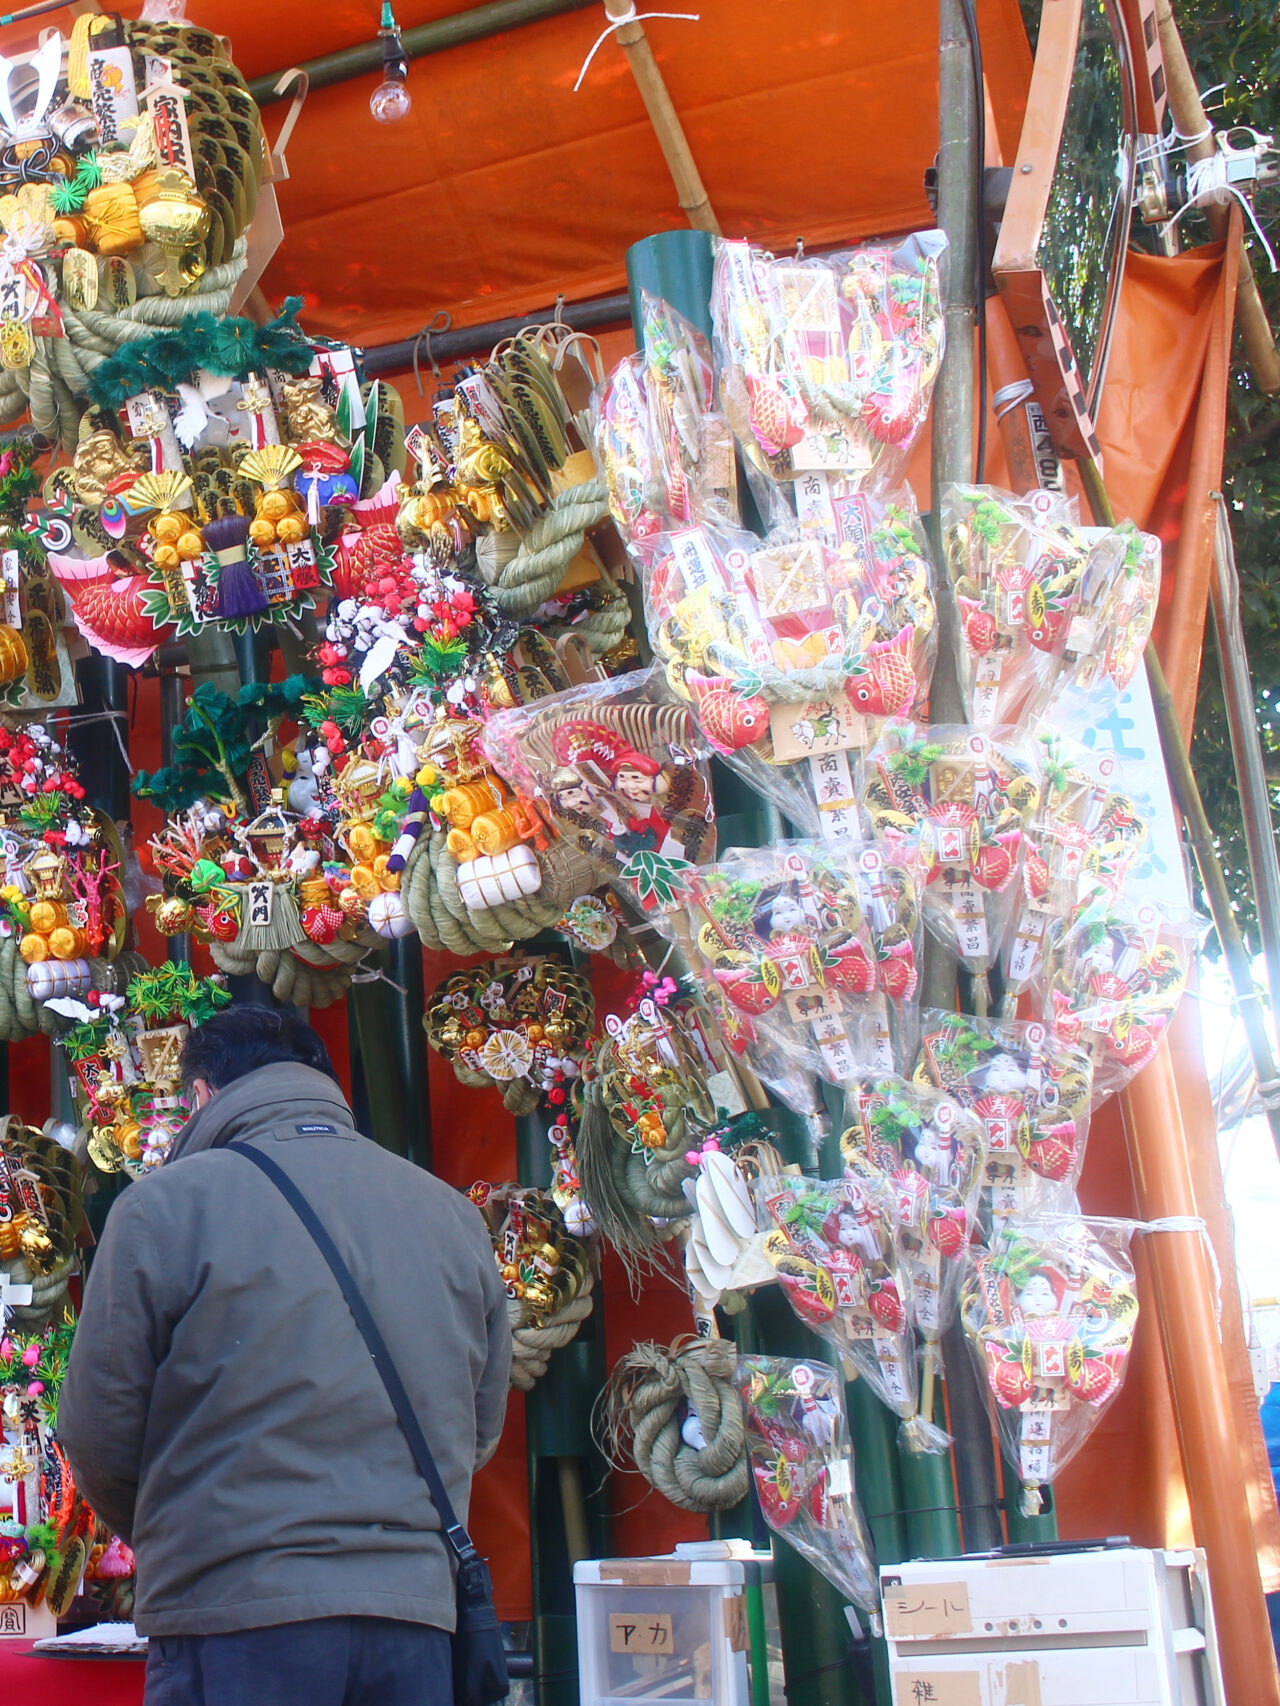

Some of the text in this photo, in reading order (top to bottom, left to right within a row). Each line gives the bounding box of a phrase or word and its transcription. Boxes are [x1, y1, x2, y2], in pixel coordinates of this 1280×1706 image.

[251, 885, 270, 922] 笑門
[897, 1599, 963, 1618] シール
